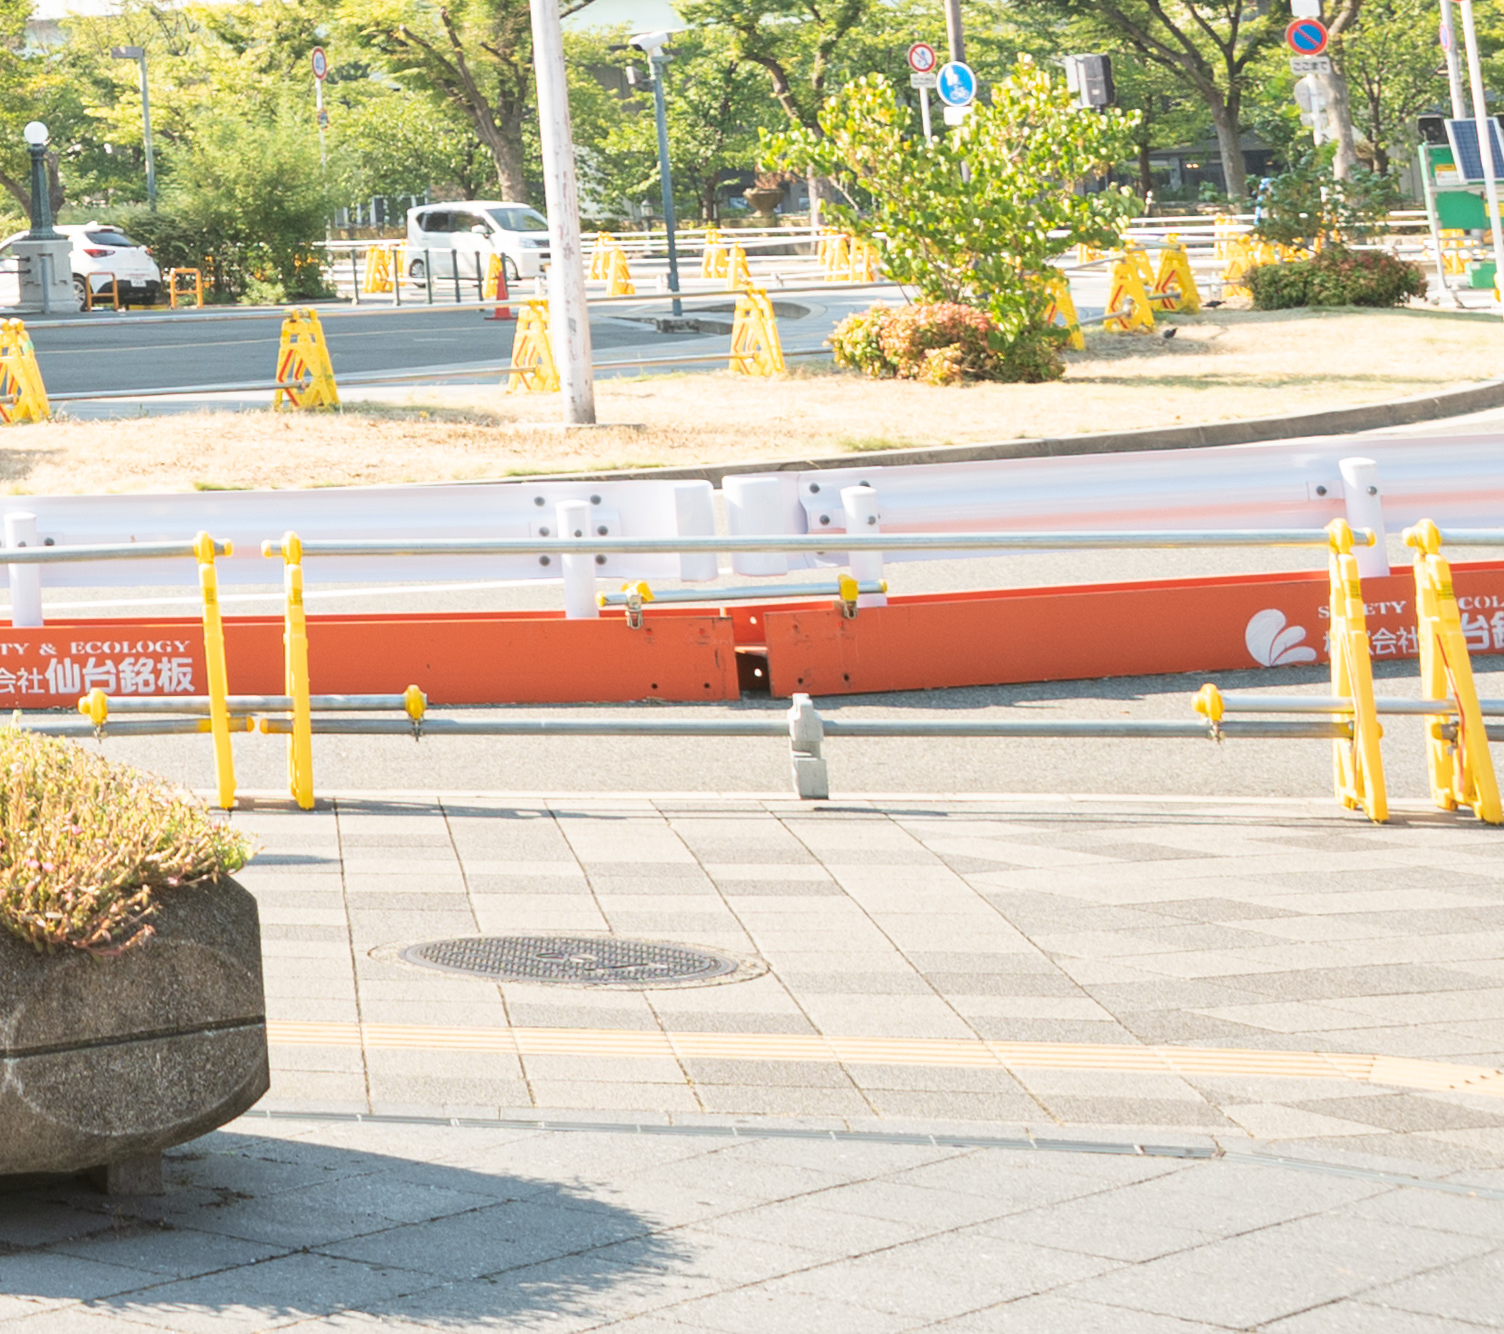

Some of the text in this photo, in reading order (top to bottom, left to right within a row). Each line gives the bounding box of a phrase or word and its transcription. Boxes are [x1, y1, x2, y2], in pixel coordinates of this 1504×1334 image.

[1293, 61, 1328, 71] ここまで
[1318, 601, 1407, 619] SETY
[39, 642, 57, 655] &
[70, 640, 190, 655] ECOLOGY
